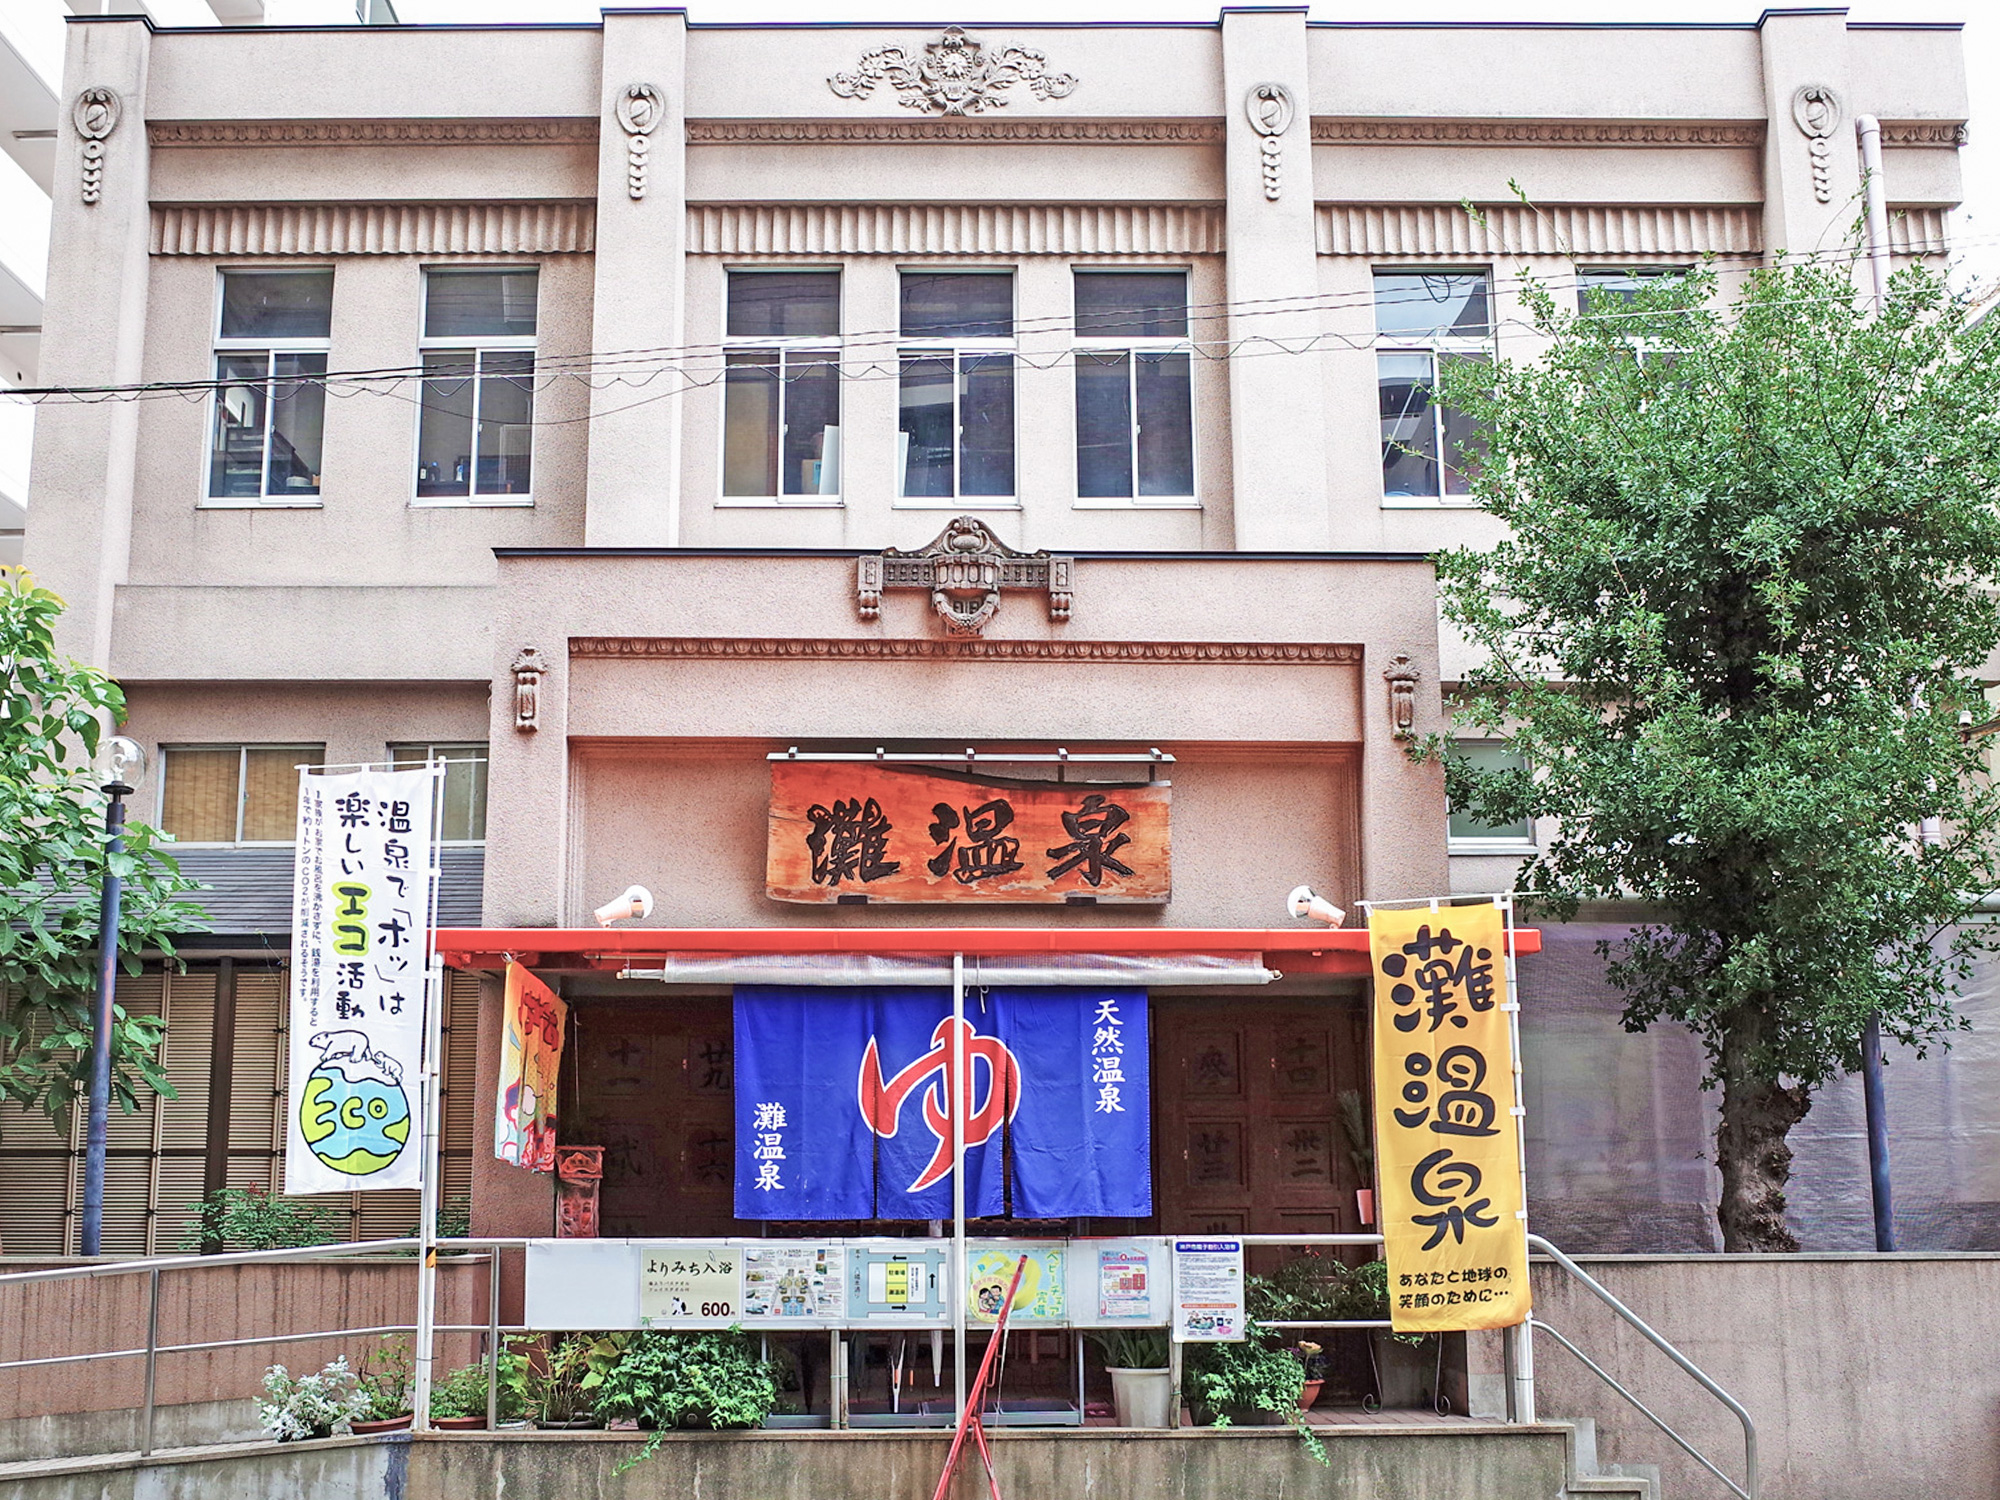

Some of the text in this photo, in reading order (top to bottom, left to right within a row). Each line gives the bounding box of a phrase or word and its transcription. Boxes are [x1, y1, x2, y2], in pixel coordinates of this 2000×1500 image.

[806, 794, 1137, 887] 灘温泉
[334, 790, 371, 1020] 楽しいエコ活動
[857, 1014, 1022, 1194] ゆ
[1091, 998, 1126, 1114] 天然温泉
[1381, 924, 1502, 1252] 灘温泉
[752, 1101, 788, 1192] 灘温泉
[646, 1259, 734, 1278] よりみち入浴
[1398, 1266, 1509, 1288] あなたと地球の
